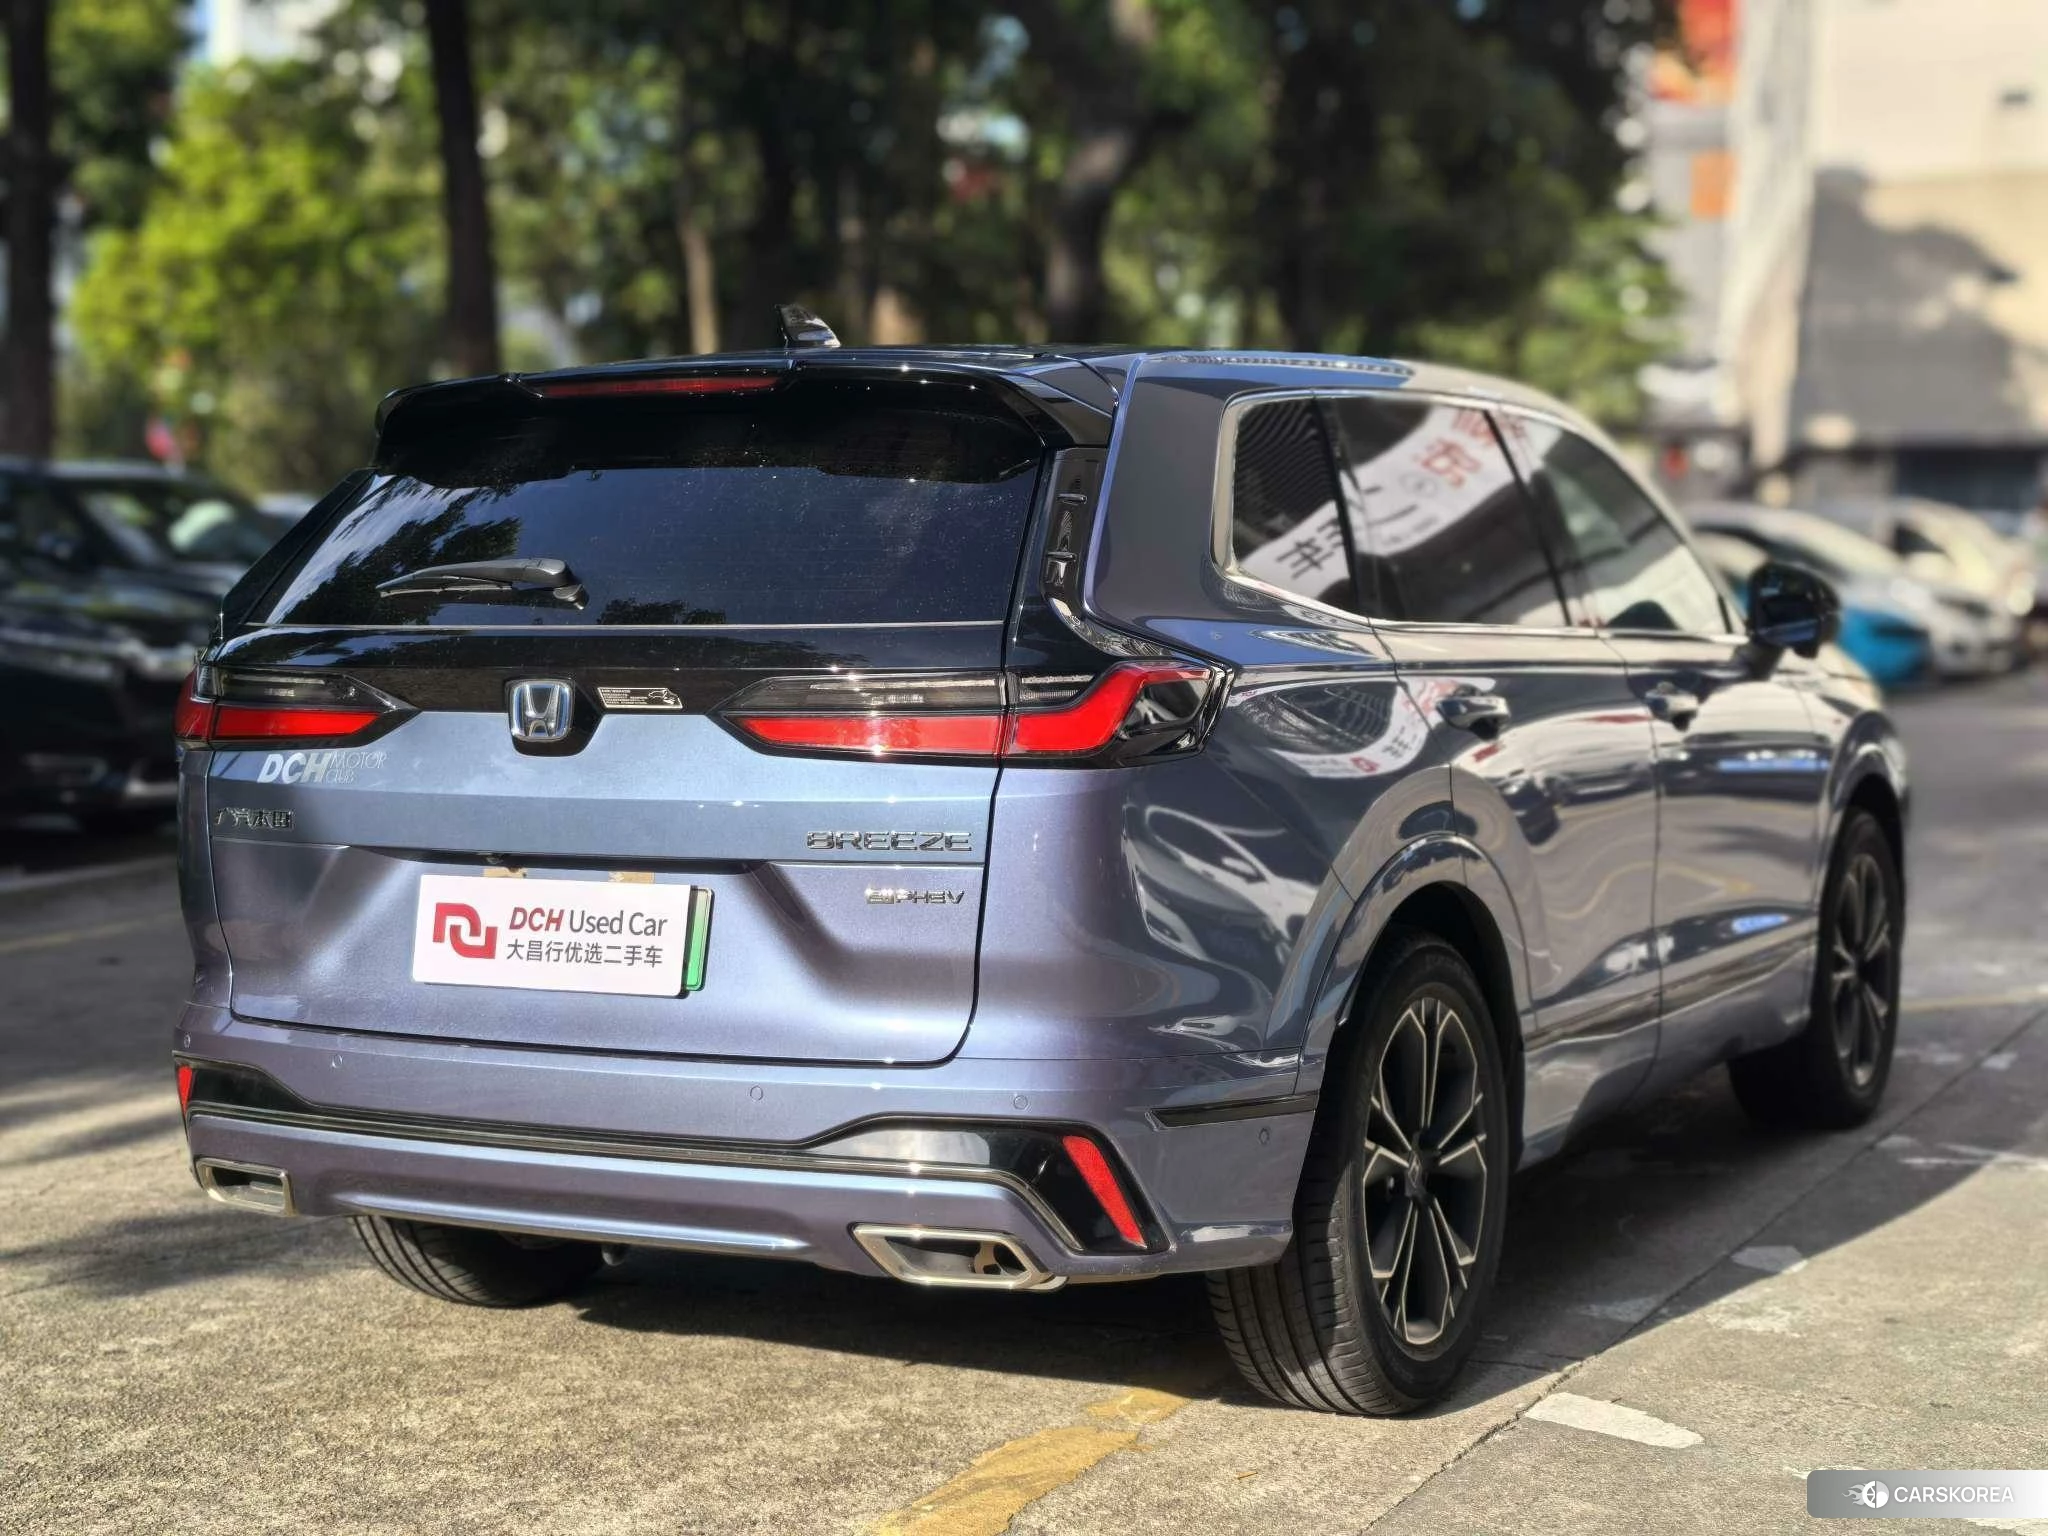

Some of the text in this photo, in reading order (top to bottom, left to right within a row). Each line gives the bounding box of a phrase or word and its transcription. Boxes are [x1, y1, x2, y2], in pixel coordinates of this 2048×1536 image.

[257, 752, 333, 783] DCH
[806, 831, 972, 851] BREEZE
[509, 906, 668, 937] DCH Used Car
[506, 938, 664, 968] 大昌行优选二手车
